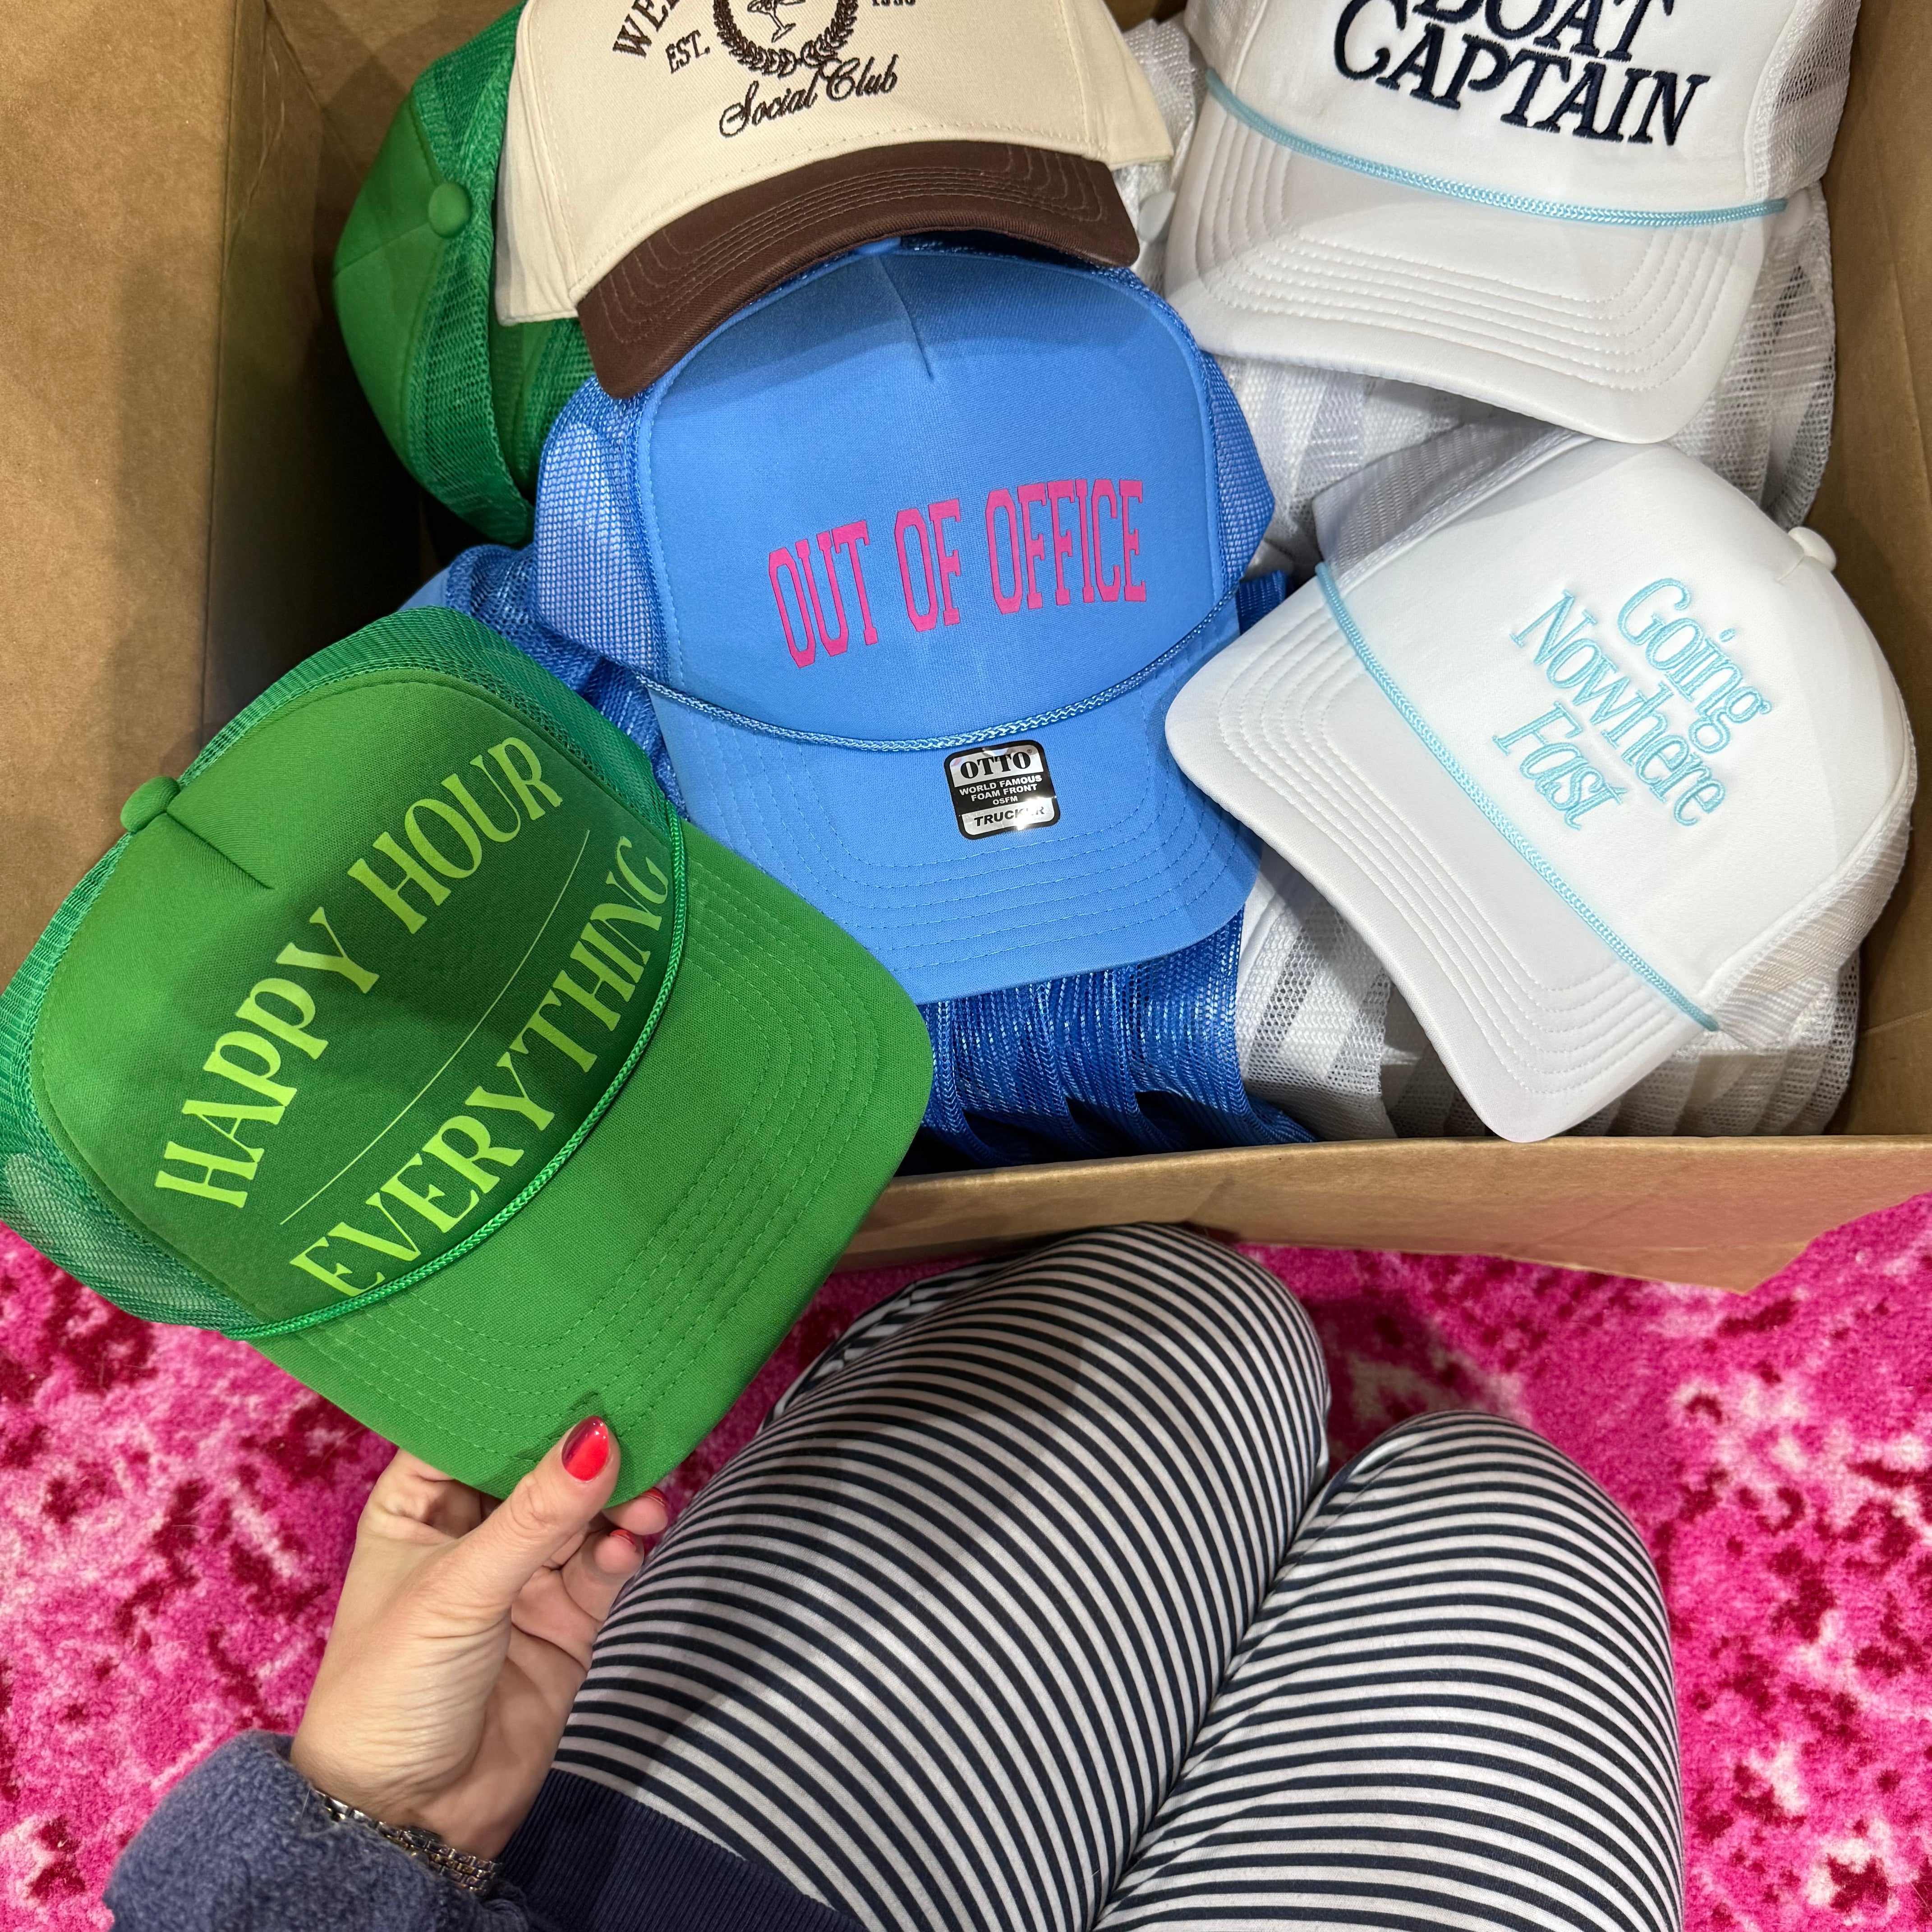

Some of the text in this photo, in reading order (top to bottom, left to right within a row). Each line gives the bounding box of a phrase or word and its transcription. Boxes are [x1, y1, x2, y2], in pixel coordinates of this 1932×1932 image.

[665, 29, 711, 74] EST.
[719, 54, 899, 138] Social Club
[1334, 0, 1711, 147] CAPTAIN
[768, 478, 1147, 668] OUT OF OFFICE
[1509, 589, 1726, 827] Nowhere
[1617, 578, 1772, 754] Going
[959, 774, 1043, 796] WORLD FAMOUS
[960, 751, 1031, 779] OTTO
[971, 783, 1038, 802] FOAM FRONT
[974, 806, 1045, 827] TRUCKR
[992, 796, 1018, 805] OSFM
[1491, 701, 1628, 831] Fast
[155, 737, 562, 1209] HAPPY HOUR
[289, 835, 669, 1297] EVERYTHING
